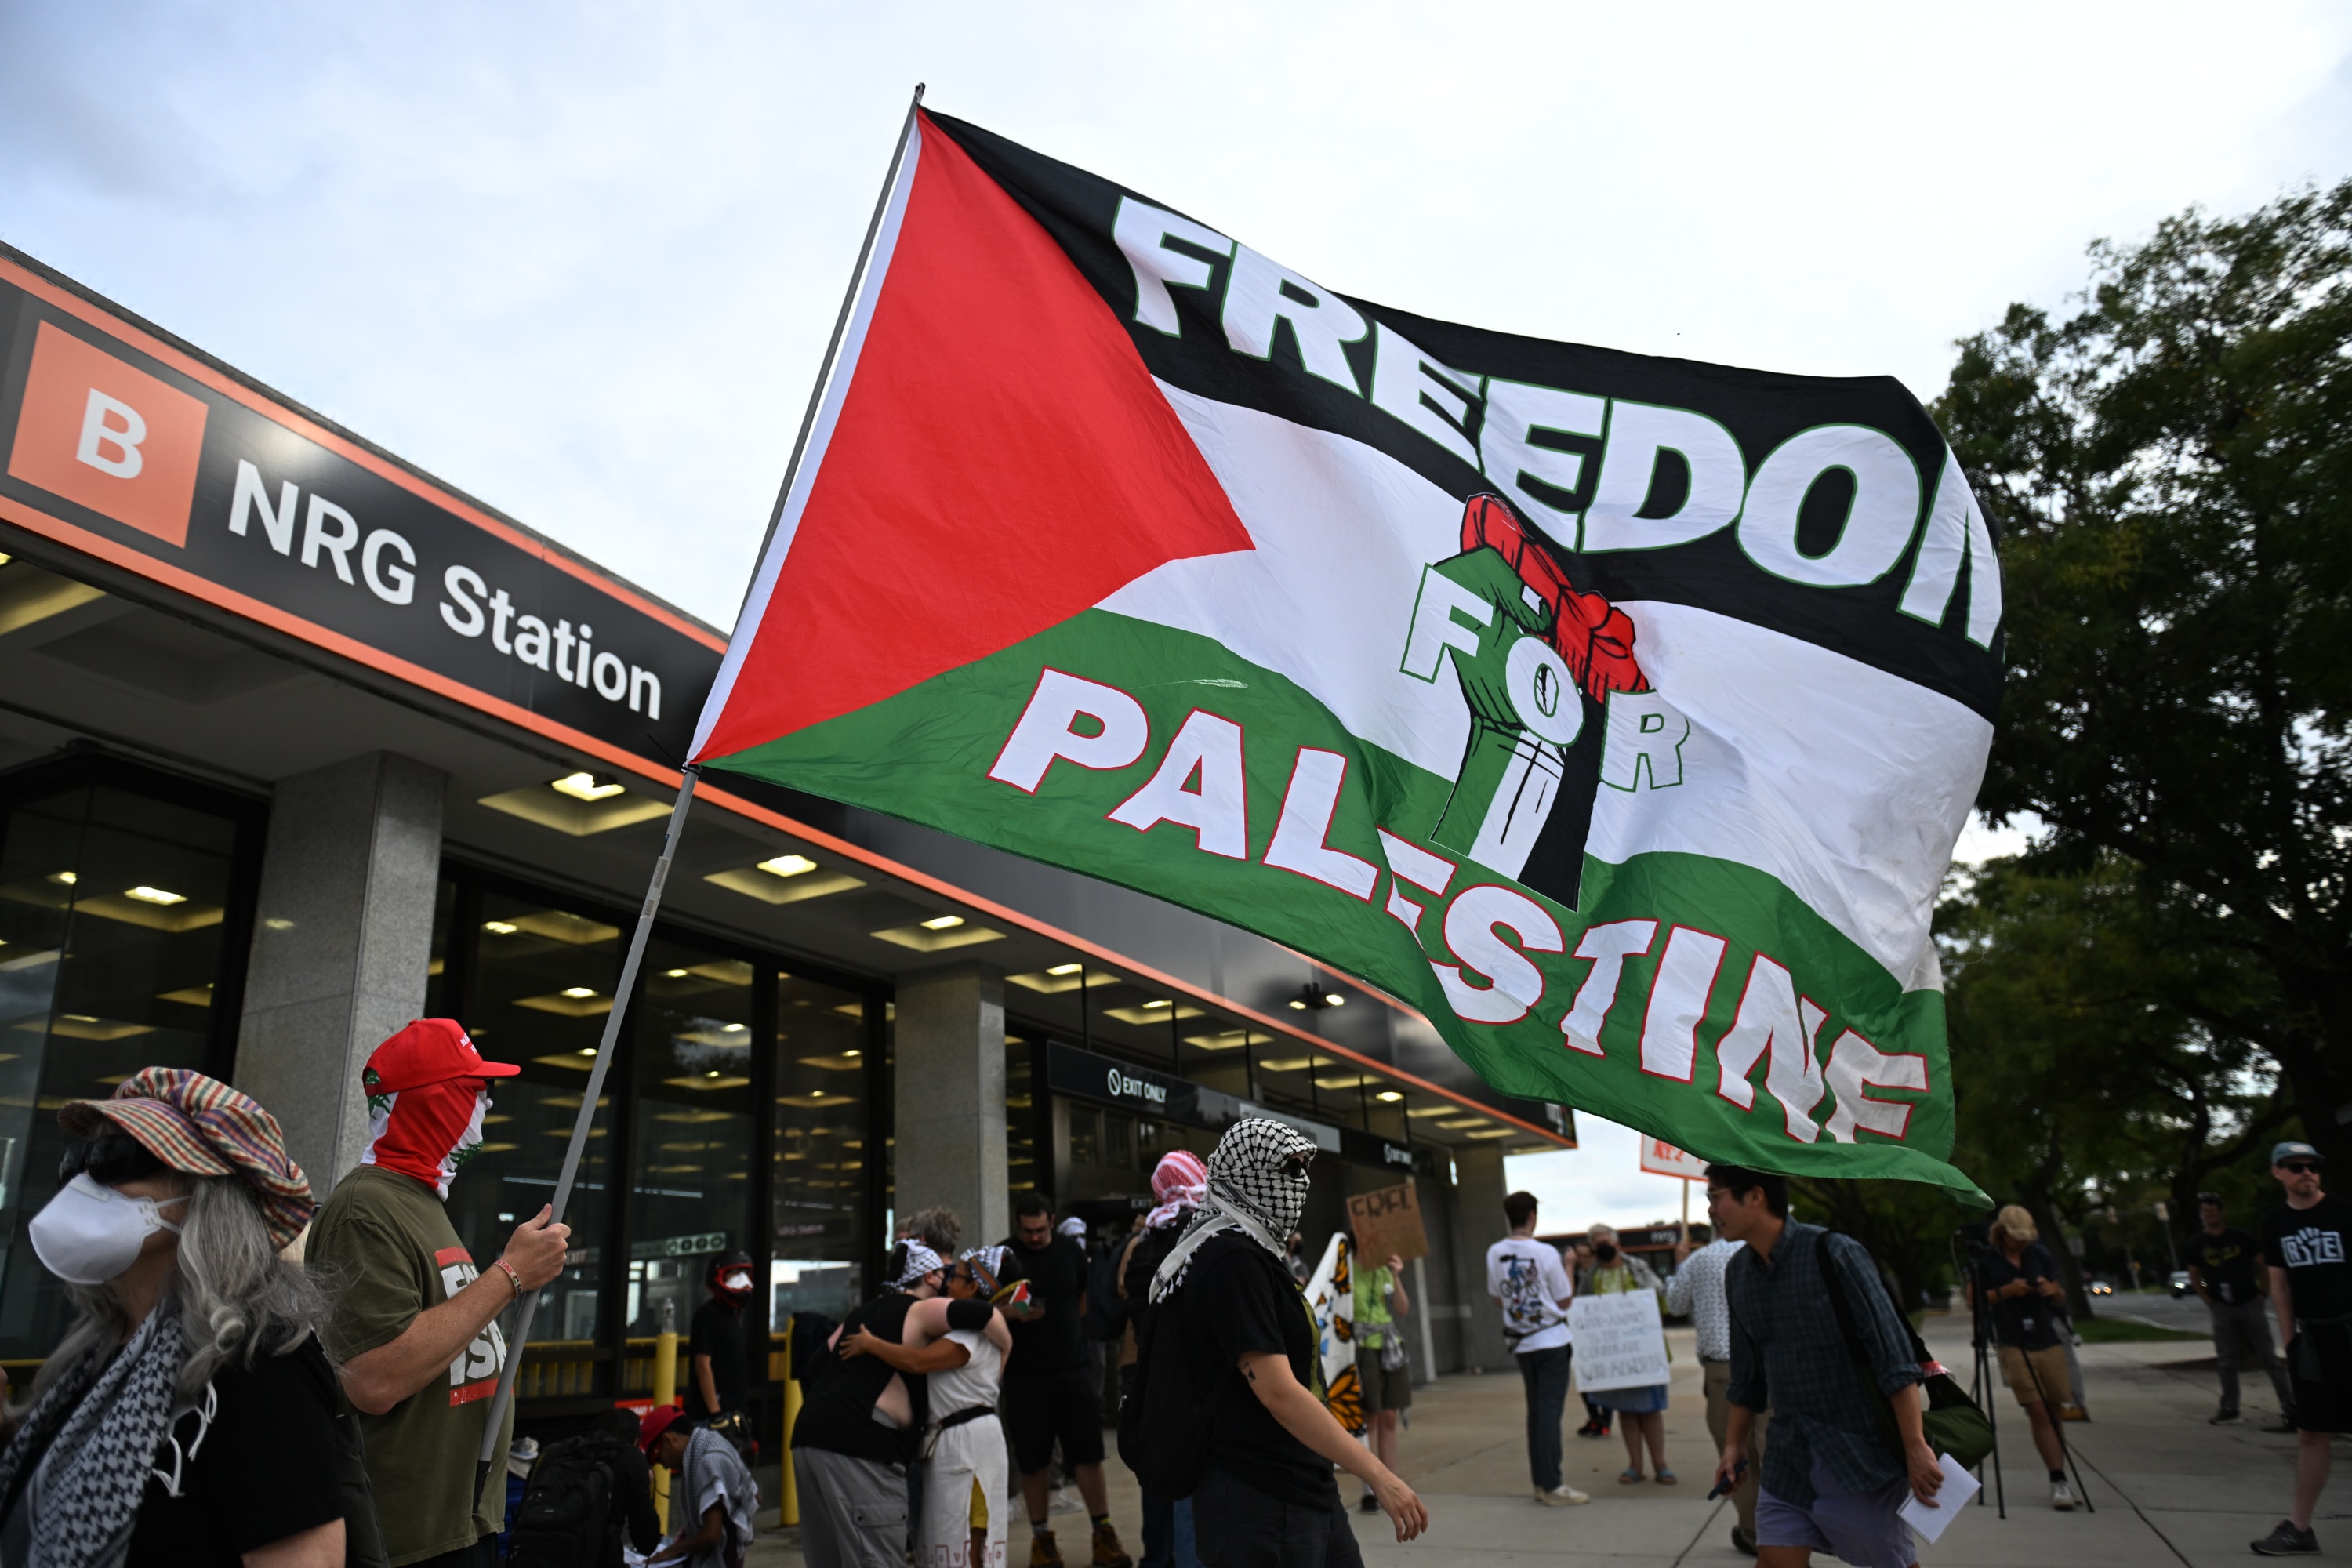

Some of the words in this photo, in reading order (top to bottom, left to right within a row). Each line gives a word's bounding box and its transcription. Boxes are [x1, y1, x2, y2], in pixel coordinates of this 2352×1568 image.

[75, 387, 147, 479] B
[228, 458, 417, 605] NRG
[439, 564, 662, 720] Station
[1399, 562, 1690, 793] FOR
[985, 664, 1931, 1144] PALESTINE
[1122, 1076, 1144, 1098] EXIT
[1143, 1082, 1167, 1104] ONLY
